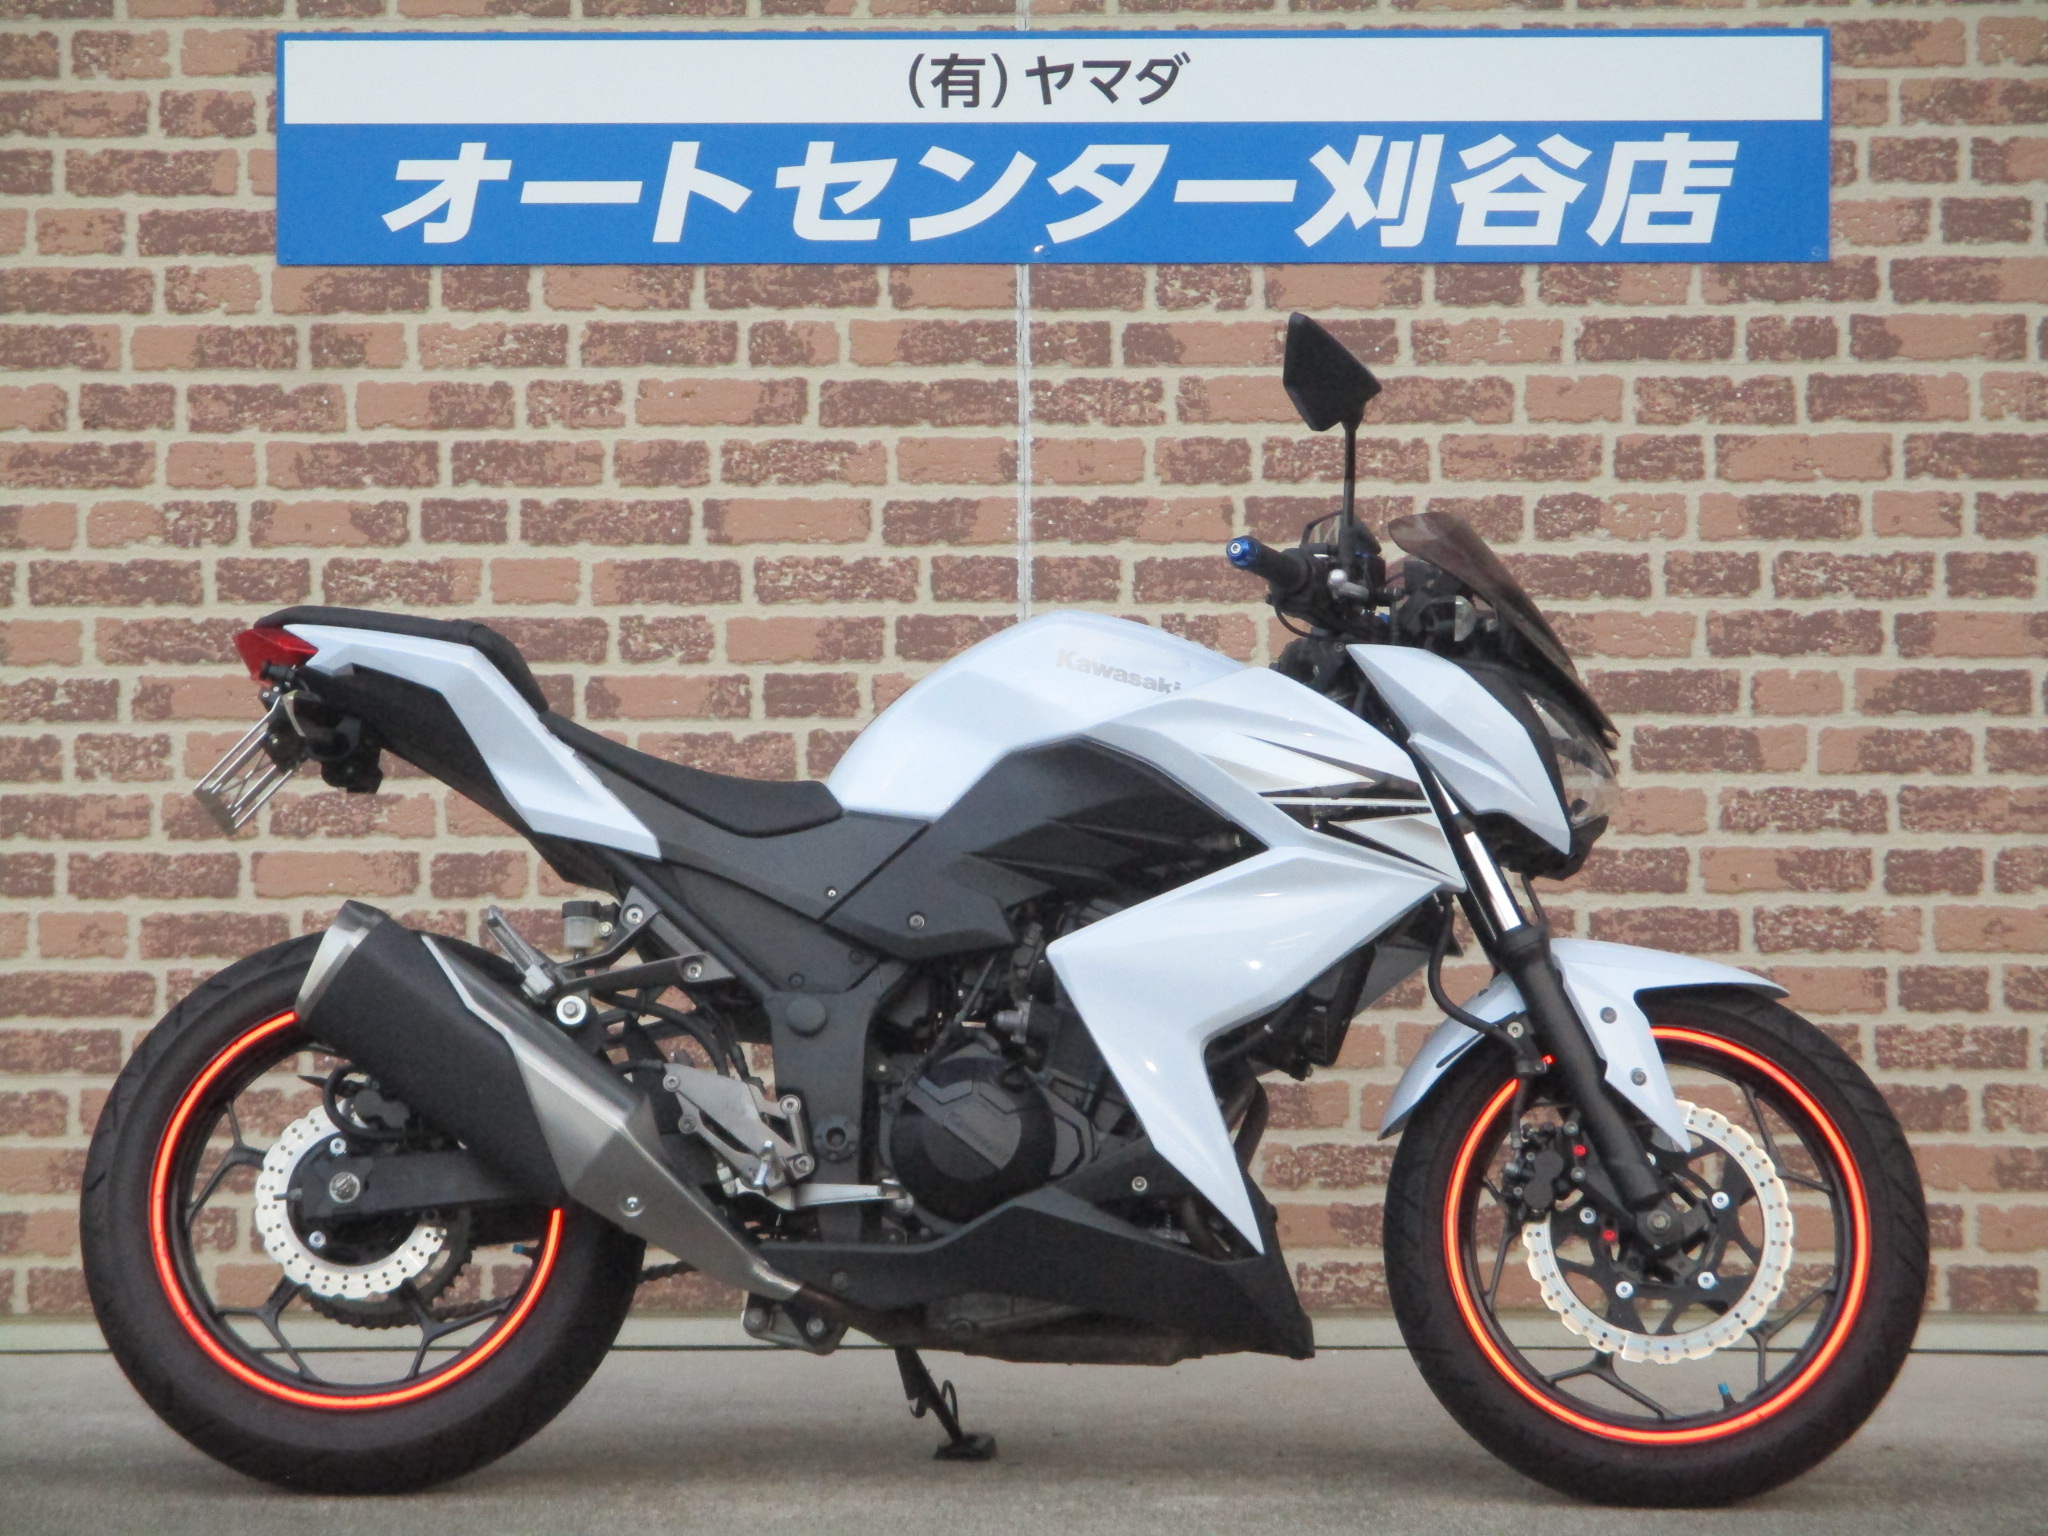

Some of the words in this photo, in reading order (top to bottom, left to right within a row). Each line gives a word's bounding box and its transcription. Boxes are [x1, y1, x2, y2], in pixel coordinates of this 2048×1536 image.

[382, 132, 1738, 247] オートセンター刈谷店
[1056, 650, 1181, 694] Kawasaki
